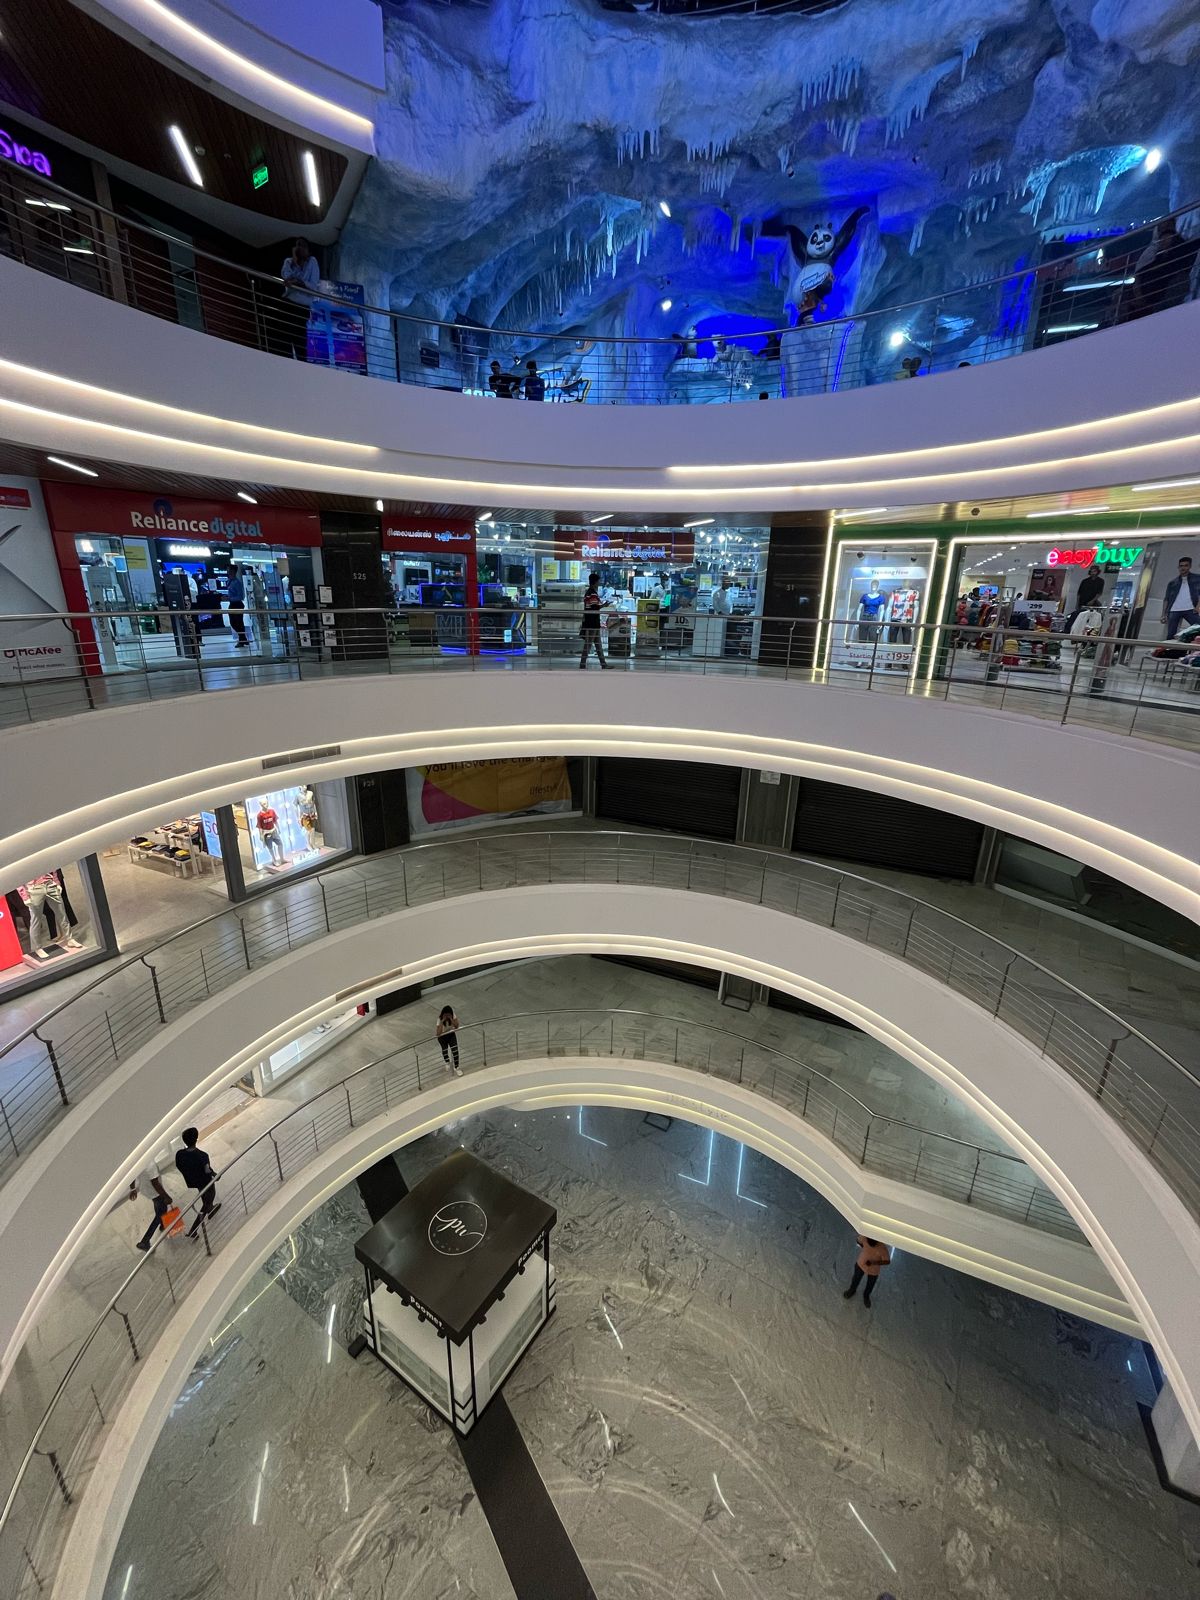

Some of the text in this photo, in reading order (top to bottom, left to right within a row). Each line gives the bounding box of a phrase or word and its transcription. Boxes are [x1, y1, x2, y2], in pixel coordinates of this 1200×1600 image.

[130, 510, 263, 539] Reliance digital
[18, 647, 62, 657] McAfee
